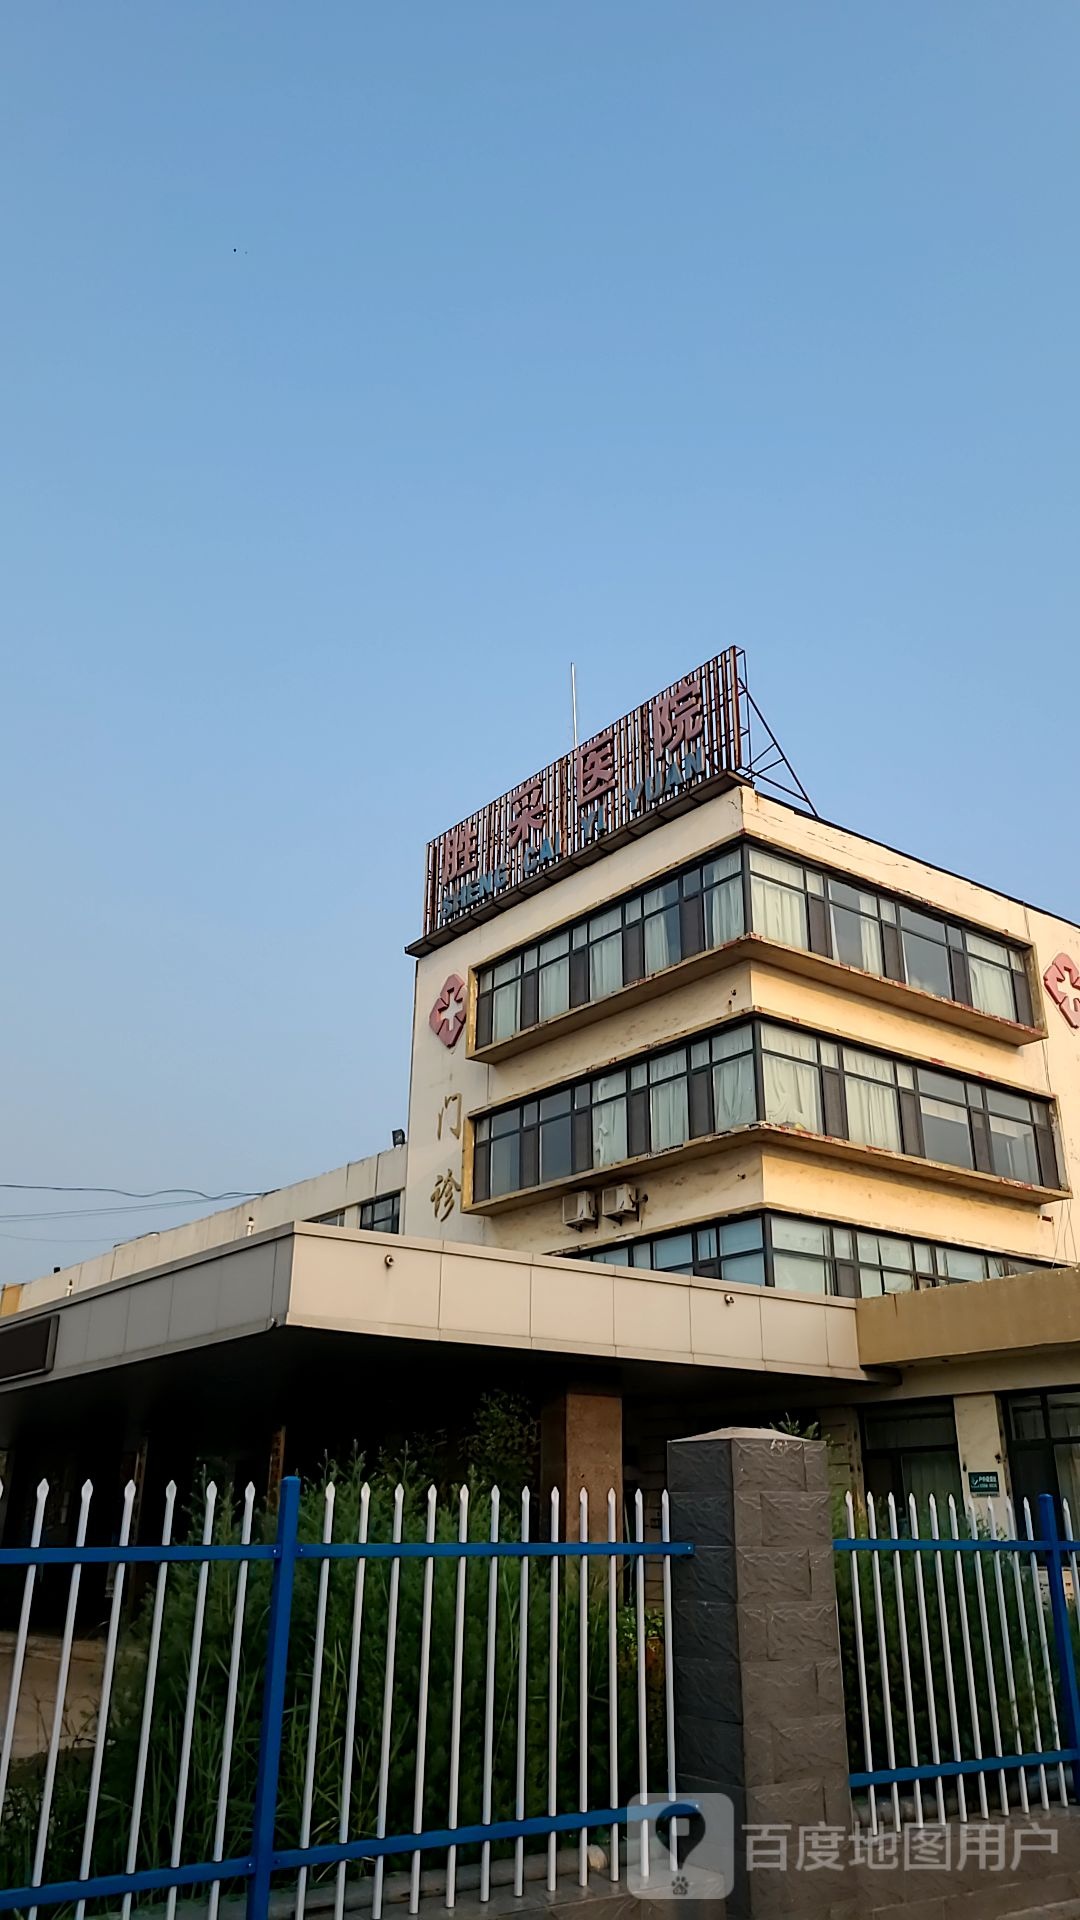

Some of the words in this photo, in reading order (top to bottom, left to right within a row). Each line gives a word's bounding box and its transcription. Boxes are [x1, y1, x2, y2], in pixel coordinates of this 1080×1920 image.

[440, 864, 509, 920] SHENG
[523, 832, 563, 873] CAI
[580, 806, 607, 842] YI
[626, 747, 705, 814] YUAN
[441, 679, 704, 886] 胜采医院
[430, 1092, 462, 1222] 门诊
